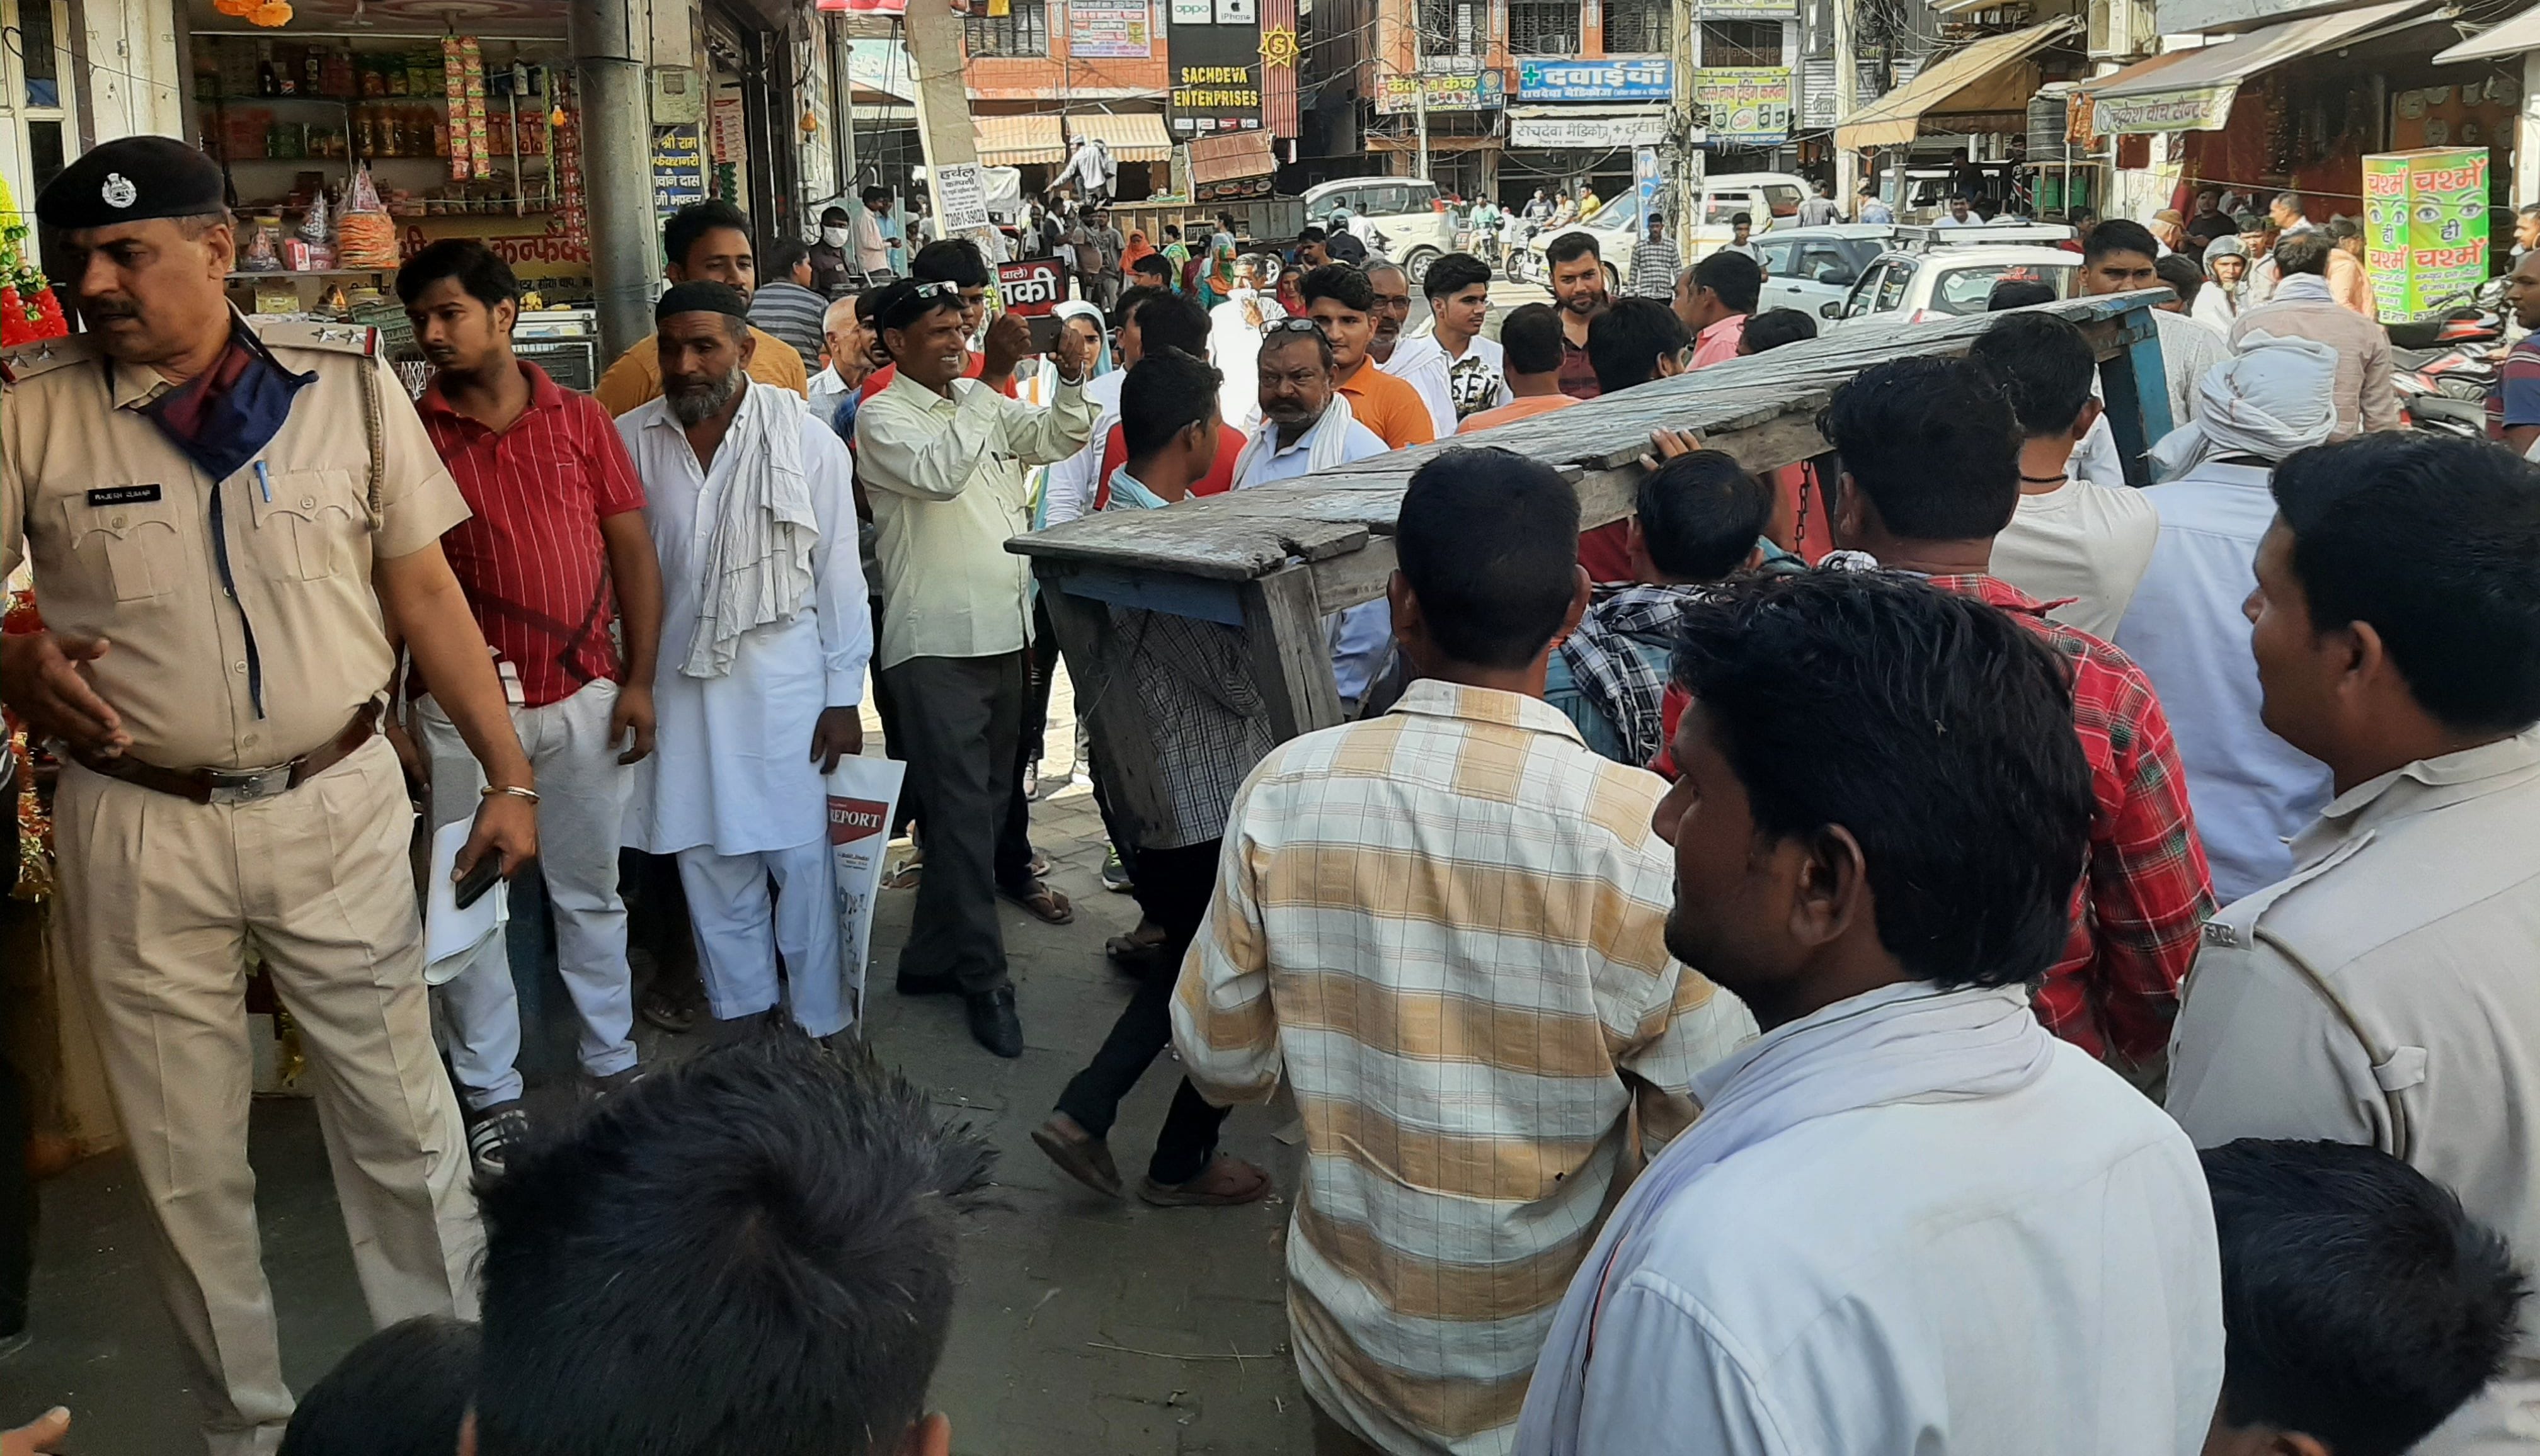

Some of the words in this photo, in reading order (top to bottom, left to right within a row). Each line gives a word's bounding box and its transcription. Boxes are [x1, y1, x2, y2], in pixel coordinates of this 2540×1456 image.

[1175, 5, 1209, 14] oppo
[1181, 67, 1248, 83] SACHDEVA
[1173, 90, 1259, 106] ENTERPRISES
[679, 175, 701, 186] दास
[830, 809, 881, 828] REPORT
